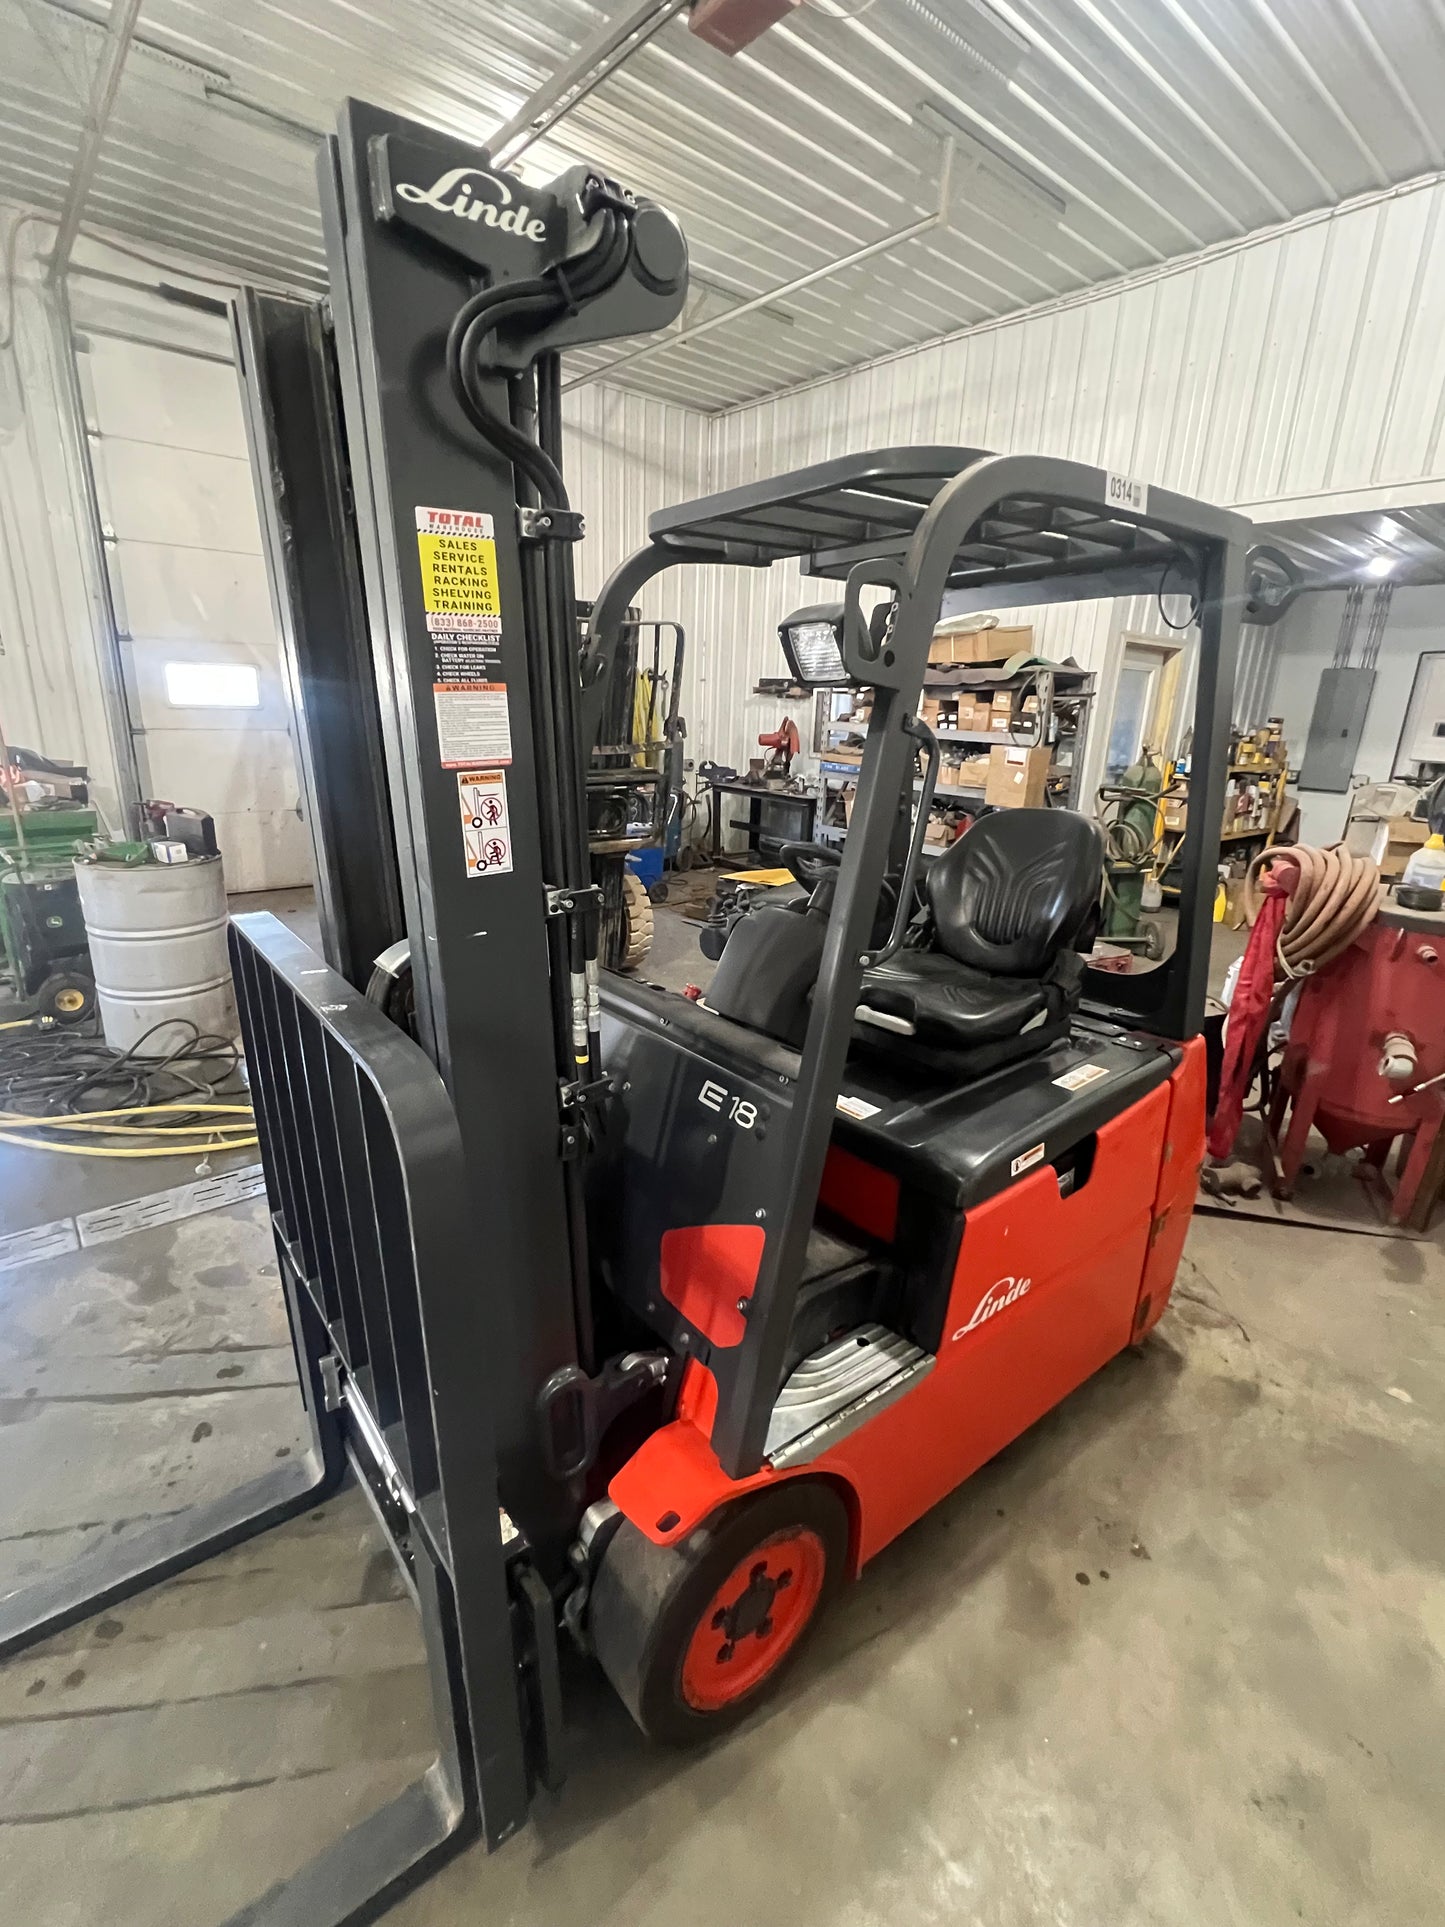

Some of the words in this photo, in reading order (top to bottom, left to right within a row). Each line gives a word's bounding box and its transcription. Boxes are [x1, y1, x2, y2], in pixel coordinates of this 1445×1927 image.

[396, 168, 546, 242] Linde
[1110, 476, 1132, 502] 0314
[428, 512, 484, 528] TOTAL
[429, 524, 484, 534] WAREHOUSE
[439, 539, 477, 550] SALES
[434, 551, 484, 563] SERVICE
[432, 563, 487, 575] RENTALS
[434, 576, 488, 587] RACKING
[433, 588, 491, 599] SHELVING
[434, 600, 492, 611] TRAINING
[431, 616, 454, 627] (833)
[457, 618, 498, 628] 868-2500
[952, 1276, 1031, 1341] Linde
